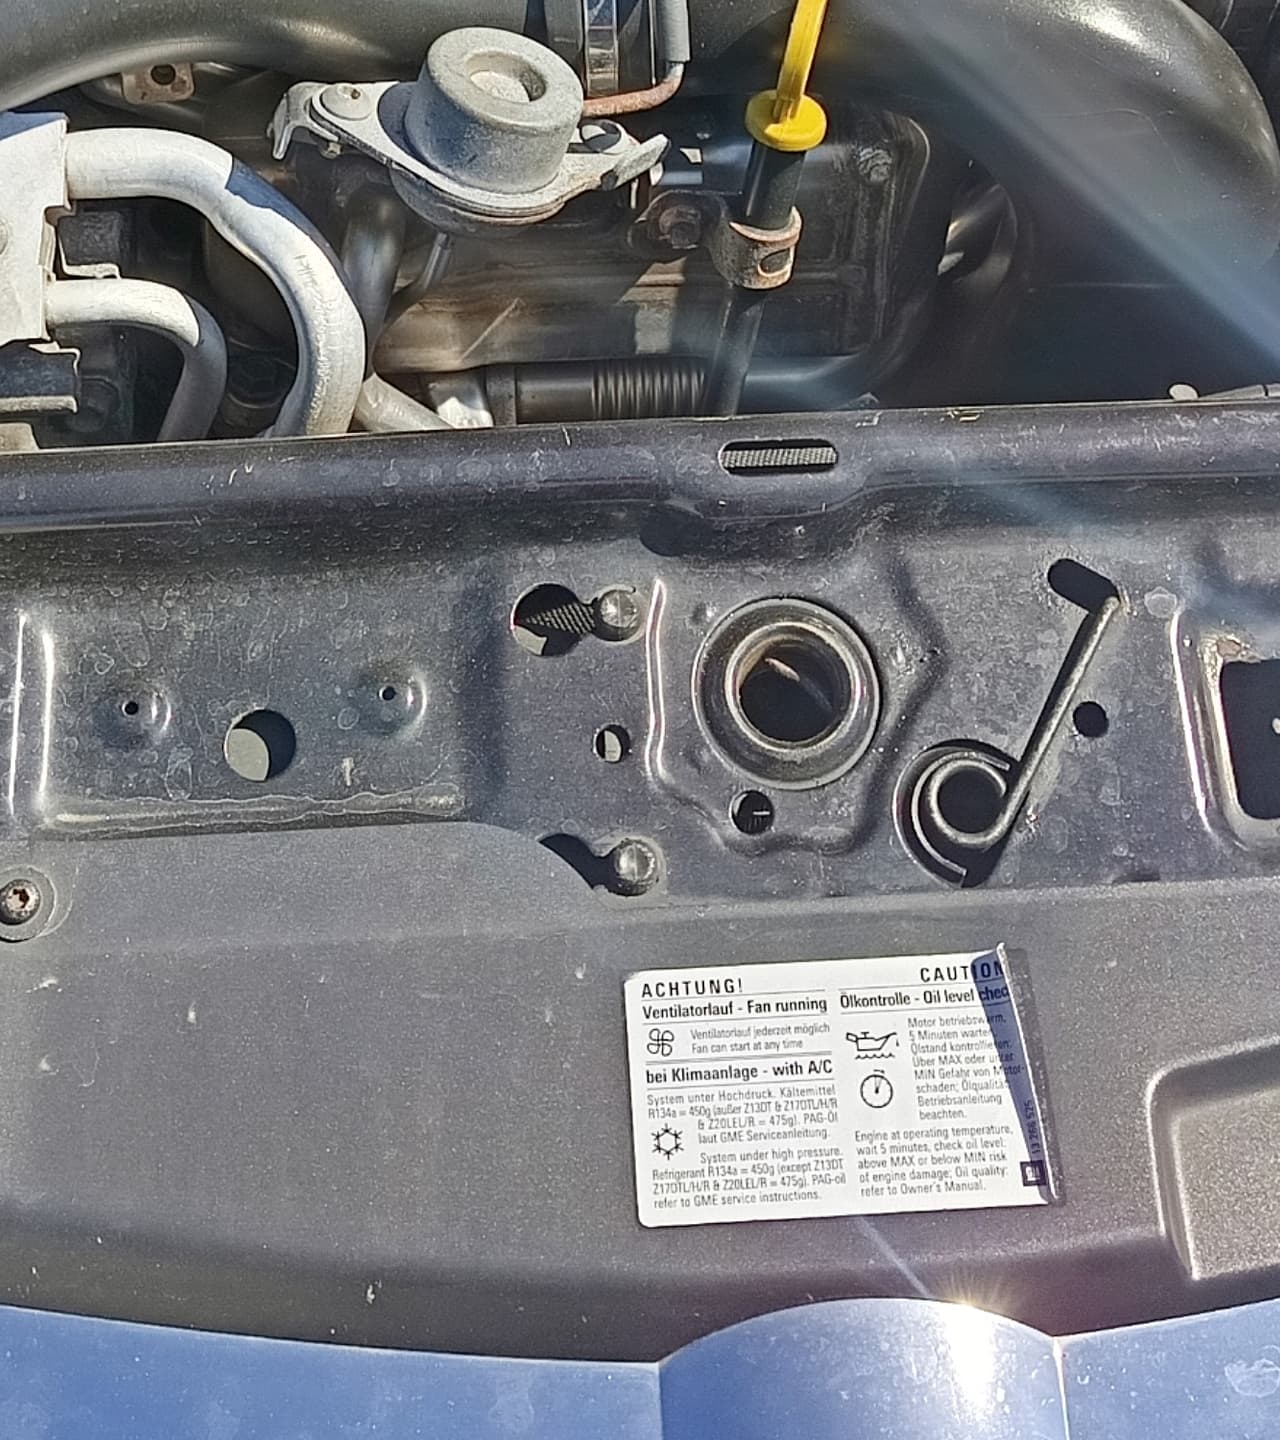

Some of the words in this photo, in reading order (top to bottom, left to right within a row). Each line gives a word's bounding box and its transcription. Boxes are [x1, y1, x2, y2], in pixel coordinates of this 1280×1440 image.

[642, 978, 743, 998] ACHTUNG!
[840, 990, 911, 1008] Ölkontrolle
[924, 988, 941, 1003] Oil
[945, 986, 974, 1001] level
[980, 984, 1008, 999] chec
[643, 1001, 733, 1020] Ventilatorlauf
[748, 999, 771, 1014] Fan
[776, 996, 827, 1014] running
[908, 1015, 936, 1028] Motor
[939, 1012, 1006, 1027] betriebswrm,
[691, 1025, 751, 1040] Ventilatorlauf
[753, 1023, 791, 1040] jederzeit
[794, 1021, 829, 1038] möglich
[918, 1029, 956, 1040] Minuten
[959, 1027, 991, 1038] warte
[692, 1042, 708, 1054] Fan
[711, 1044, 727, 1053] can
[730, 1040, 750, 1052] start
[764, 1040, 780, 1053] any
[783, 1037, 803, 1049] time
[939, 1052, 961, 1065] MAX
[965, 1051, 985, 1064] oder
[647, 1068, 666, 1084] bei
[672, 1063, 758, 1083] Klimaanlage
[773, 1060, 803, 1077] with
[809, 1058, 833, 1075] A/C
[939, 1066, 970, 1078] Gefahr
[973, 1067, 990, 1076] von
[648, 1093, 684, 1107] System
[688, 1091, 714, 1103] unter
[720, 1088, 776, 1101] Hochdruck.
[780, 1085, 835, 1098] Kältemittel
[918, 1093, 1002, 1107] Betriebsanleitung
[648, 1106, 677, 1119] R134a
[689, 1104, 710, 1118] 450g
[920, 1107, 966, 1120] beachten.
[699, 1133, 717, 1144] laut
[721, 1132, 744, 1143] GME
[747, 1127, 830, 1142] Serviceanleitung.
[856, 1130, 887, 1143] Engine
[904, 1127, 948, 1140] operating
[857, 1143, 876, 1155] wait
[934, 1139, 962, 1151] check
[966, 1138, 978, 1150] oil
[701, 1151, 736, 1166] System
[740, 1149, 768, 1161] under
[772, 1148, 794, 1162] high
[798, 1148, 843, 1161] pressure.
[858, 1157, 887, 1169] above
[891, 1156, 914, 1167] MAX
[930, 1153, 961, 1165] below
[965, 1152, 985, 1163] MIN
[989, 1150, 1006, 1162] risk
[653, 1166, 705, 1182] Refrigerant
[708, 1165, 738, 1177] R134a
[751, 1163, 774, 1177] 450g
[778, 1161, 811, 1176] (except
[873, 1170, 906, 1185] engine
[955, 1166, 968, 1177] Oil
[862, 1185, 883, 1197] refer
[945, 1179, 986, 1192] Manual.
[654, 1196, 677, 1209] refer
[694, 1194, 718, 1206] GME
[722, 1192, 756, 1205] service
